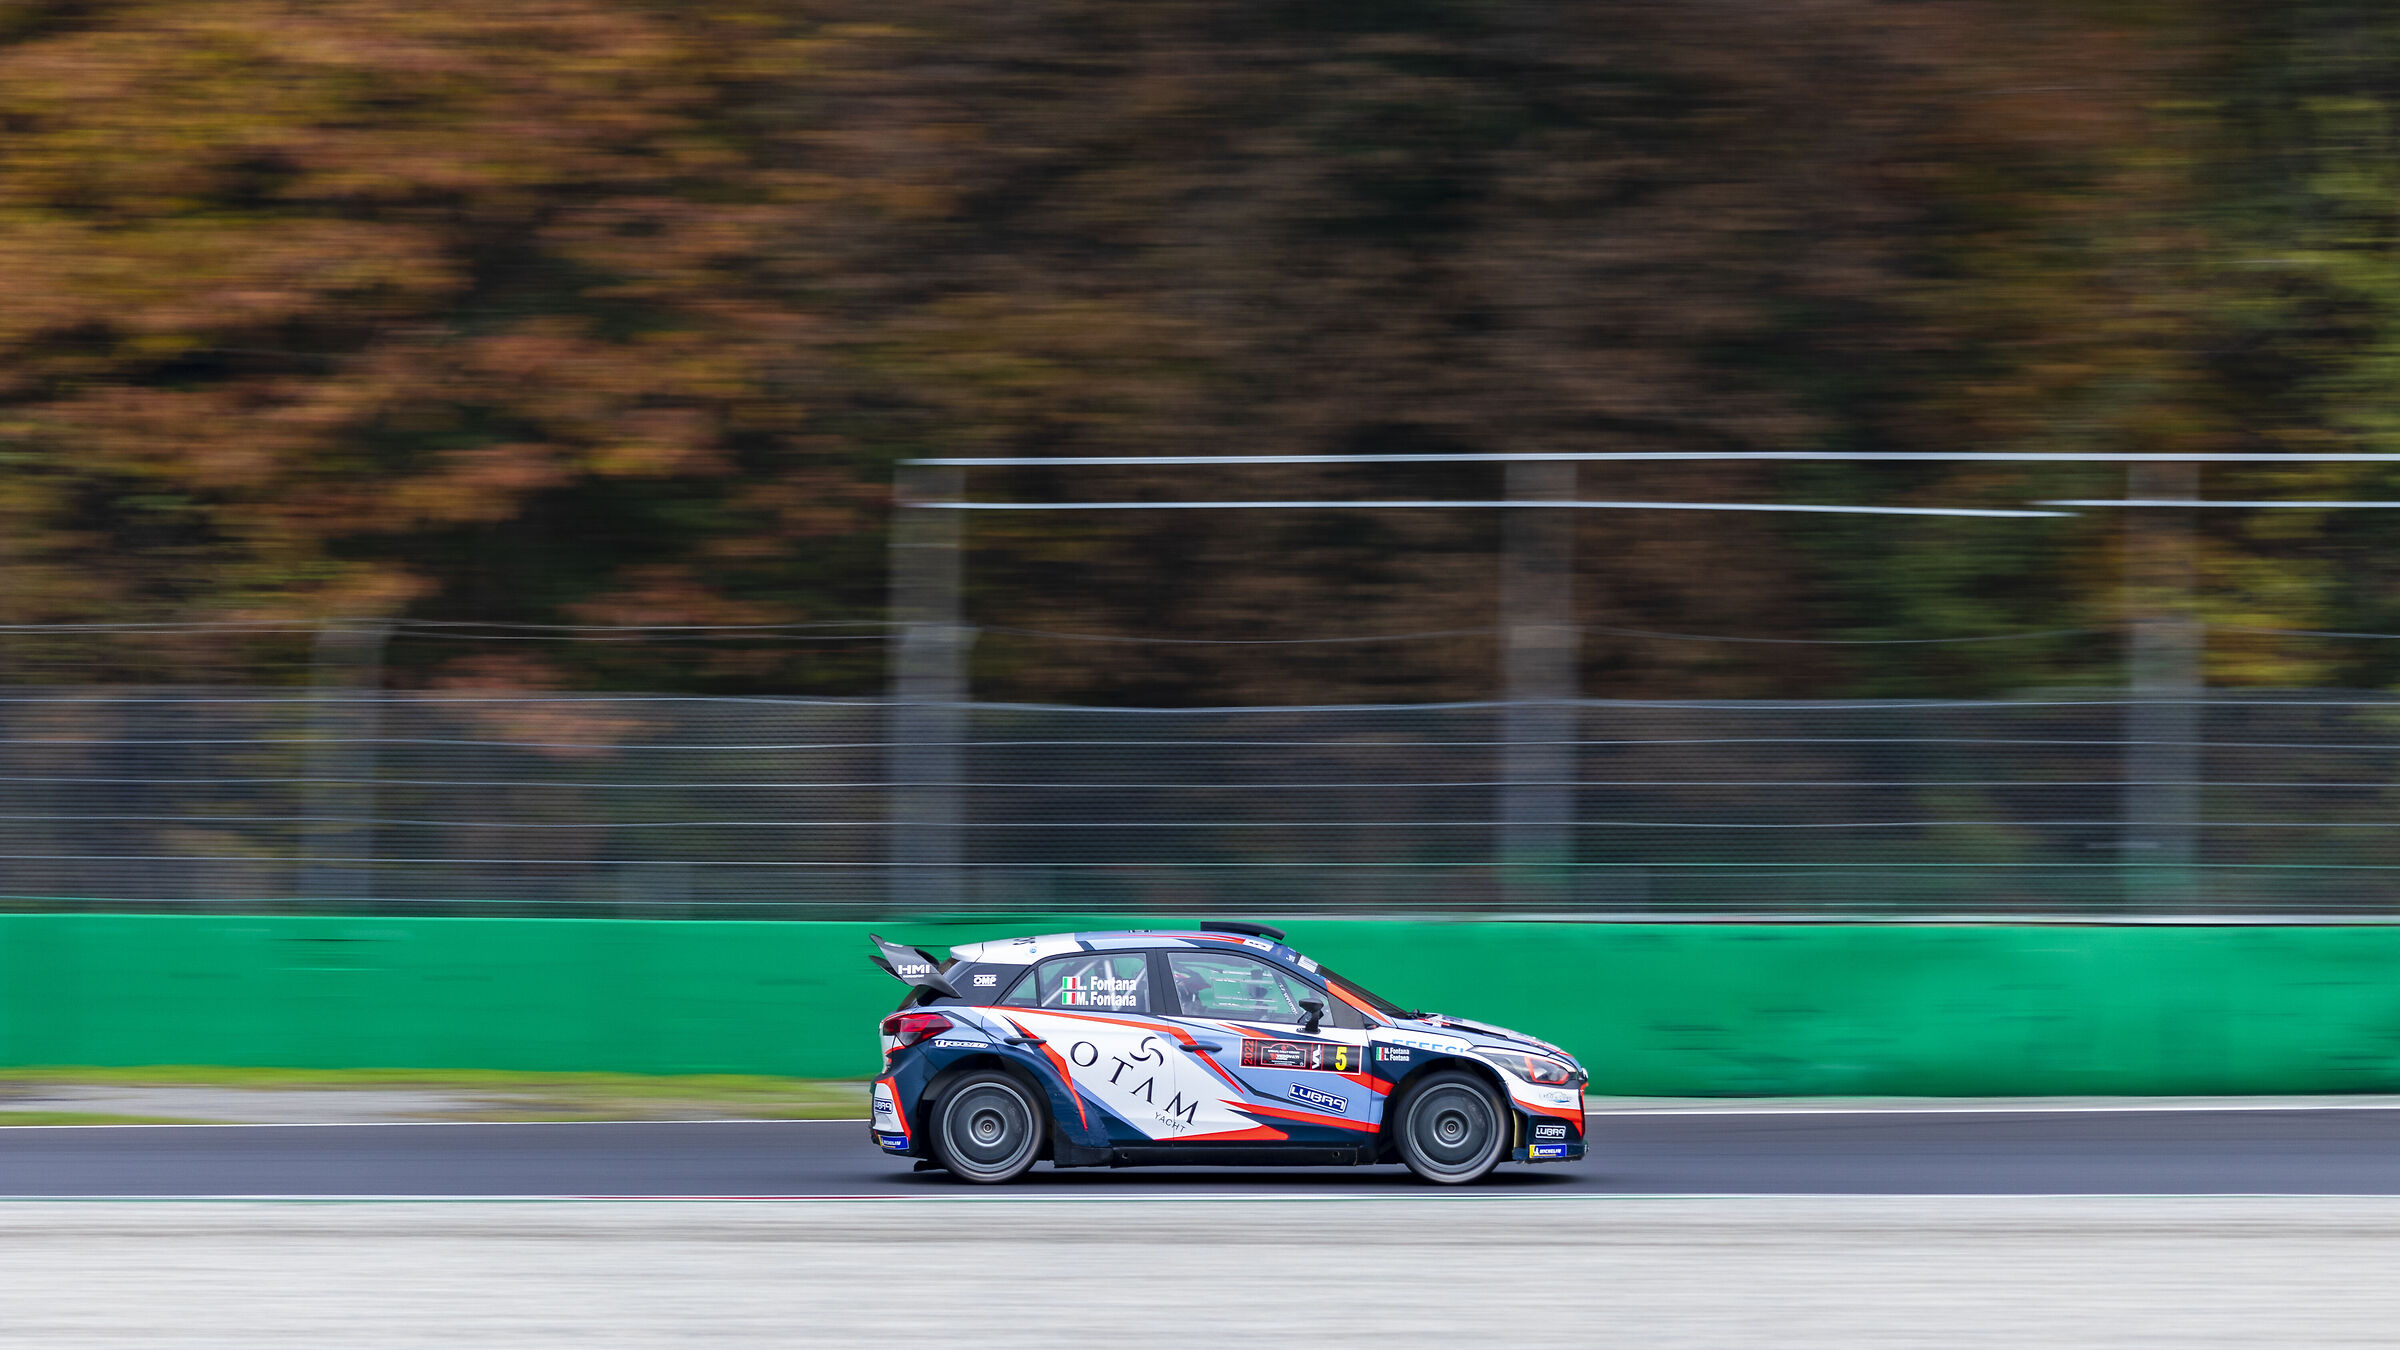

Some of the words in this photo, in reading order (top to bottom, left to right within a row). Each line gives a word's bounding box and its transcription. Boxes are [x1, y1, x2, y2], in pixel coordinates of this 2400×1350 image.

[898, 965, 930, 975] HMI
[973, 976, 997, 985] OMP
[1077, 976, 1087, 990] L.
[1090, 976, 1137, 991] Fontana
[1076, 991, 1088, 1005] M.
[1090, 992, 1137, 1007] Fontana
[1243, 1040, 1254, 1065] 2022
[1335, 1046, 1348, 1071] 5
[1390, 1047, 1410, 1056] Fontana
[1390, 1054, 1410, 1062] Fontana
[1154, 1111, 1186, 1133] YACHT
